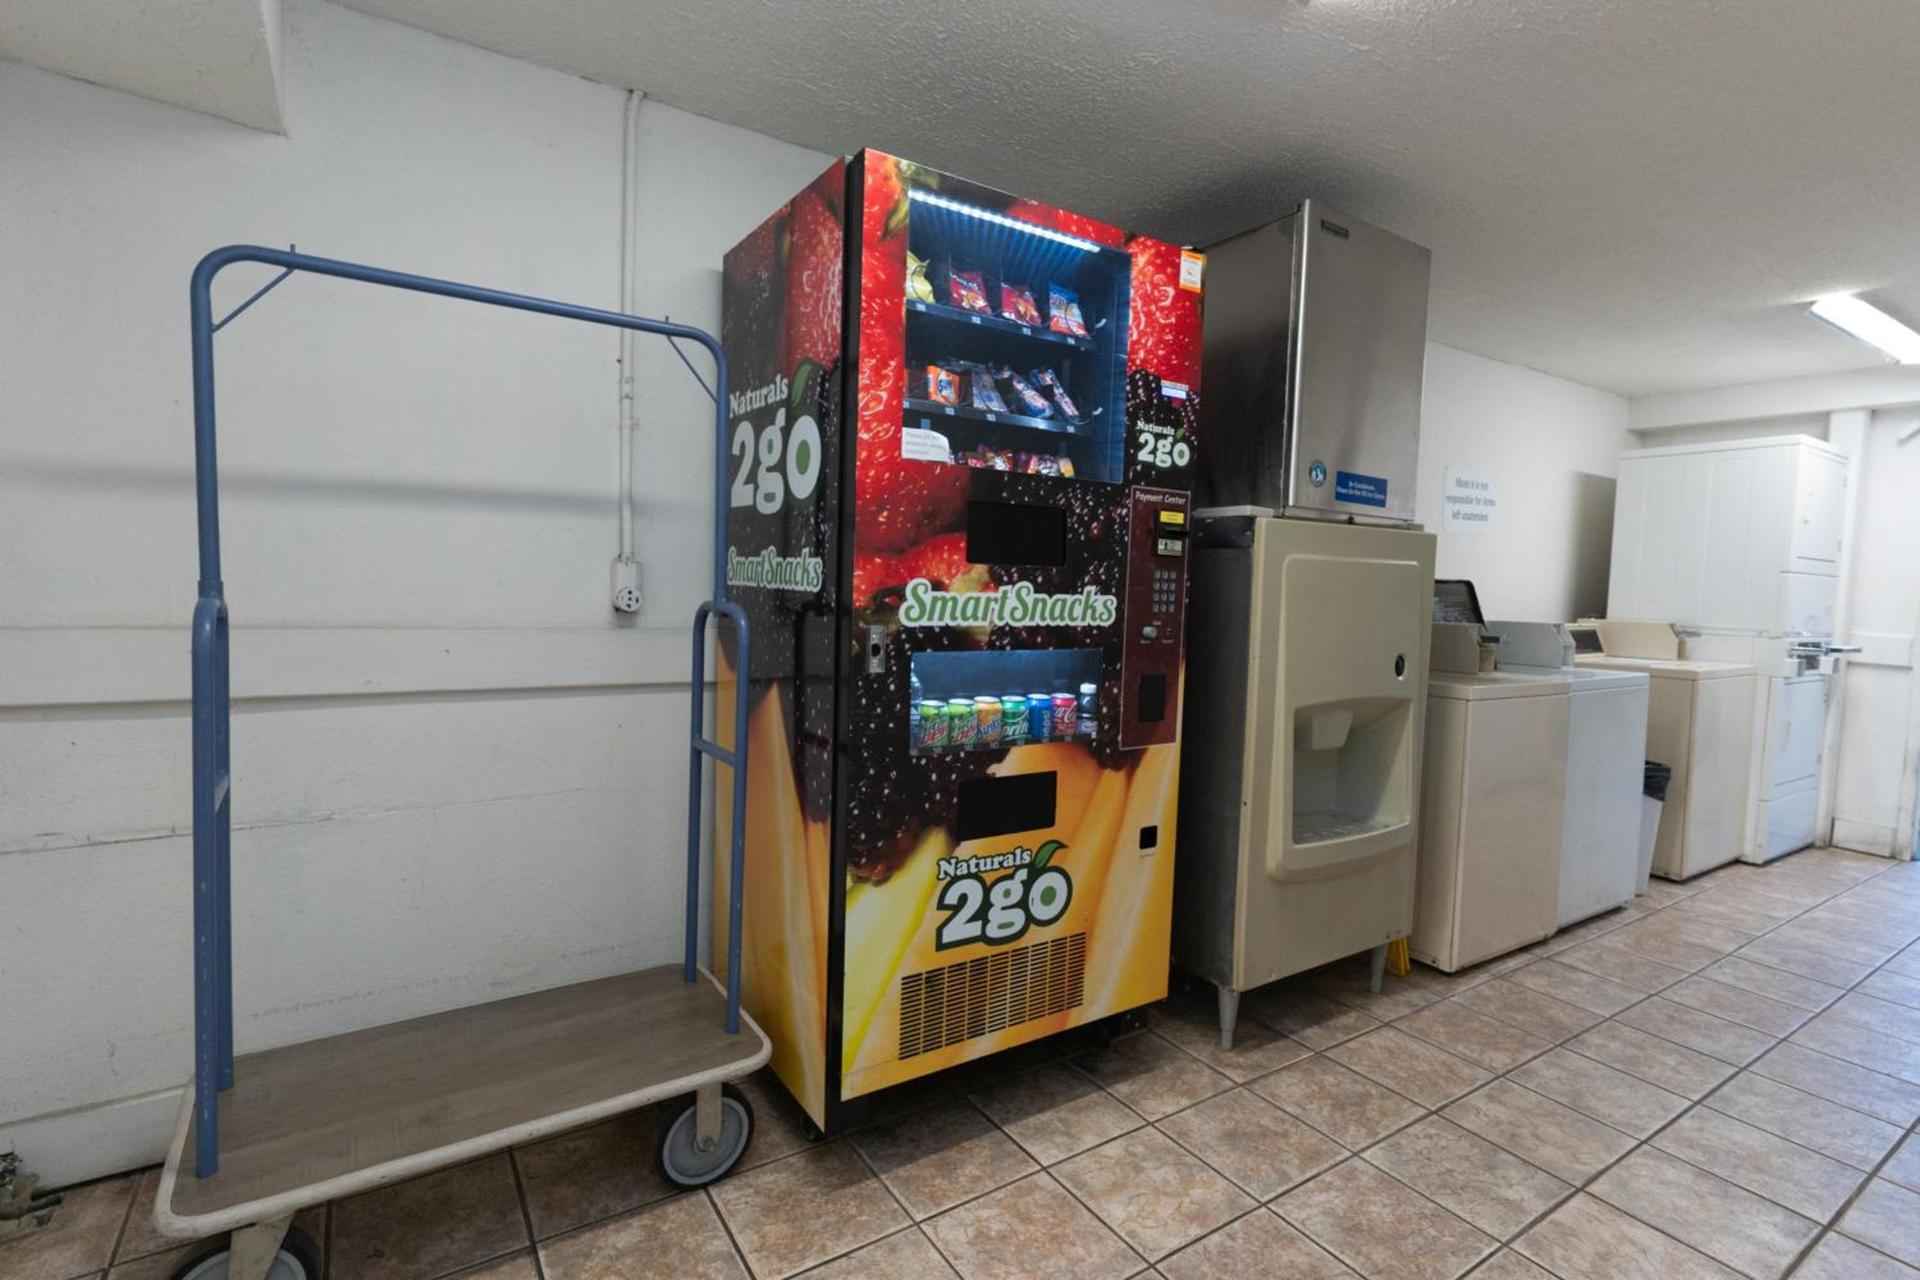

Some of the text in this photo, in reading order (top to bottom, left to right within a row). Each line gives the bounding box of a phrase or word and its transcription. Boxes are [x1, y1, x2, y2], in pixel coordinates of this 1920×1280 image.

[729, 373, 788, 418] Naturals
[1135, 419, 1175, 436] Naturals
[1138, 432, 1190, 467] 2go
[731, 407, 822, 514] 2go
[1135, 490, 1186, 504] Payment Center
[728, 547, 822, 591] SmartSnacks
[900, 578, 1117, 627] SmartSnacks
[937, 847, 1033, 880] Naturals
[937, 867, 1071, 949] 2go
